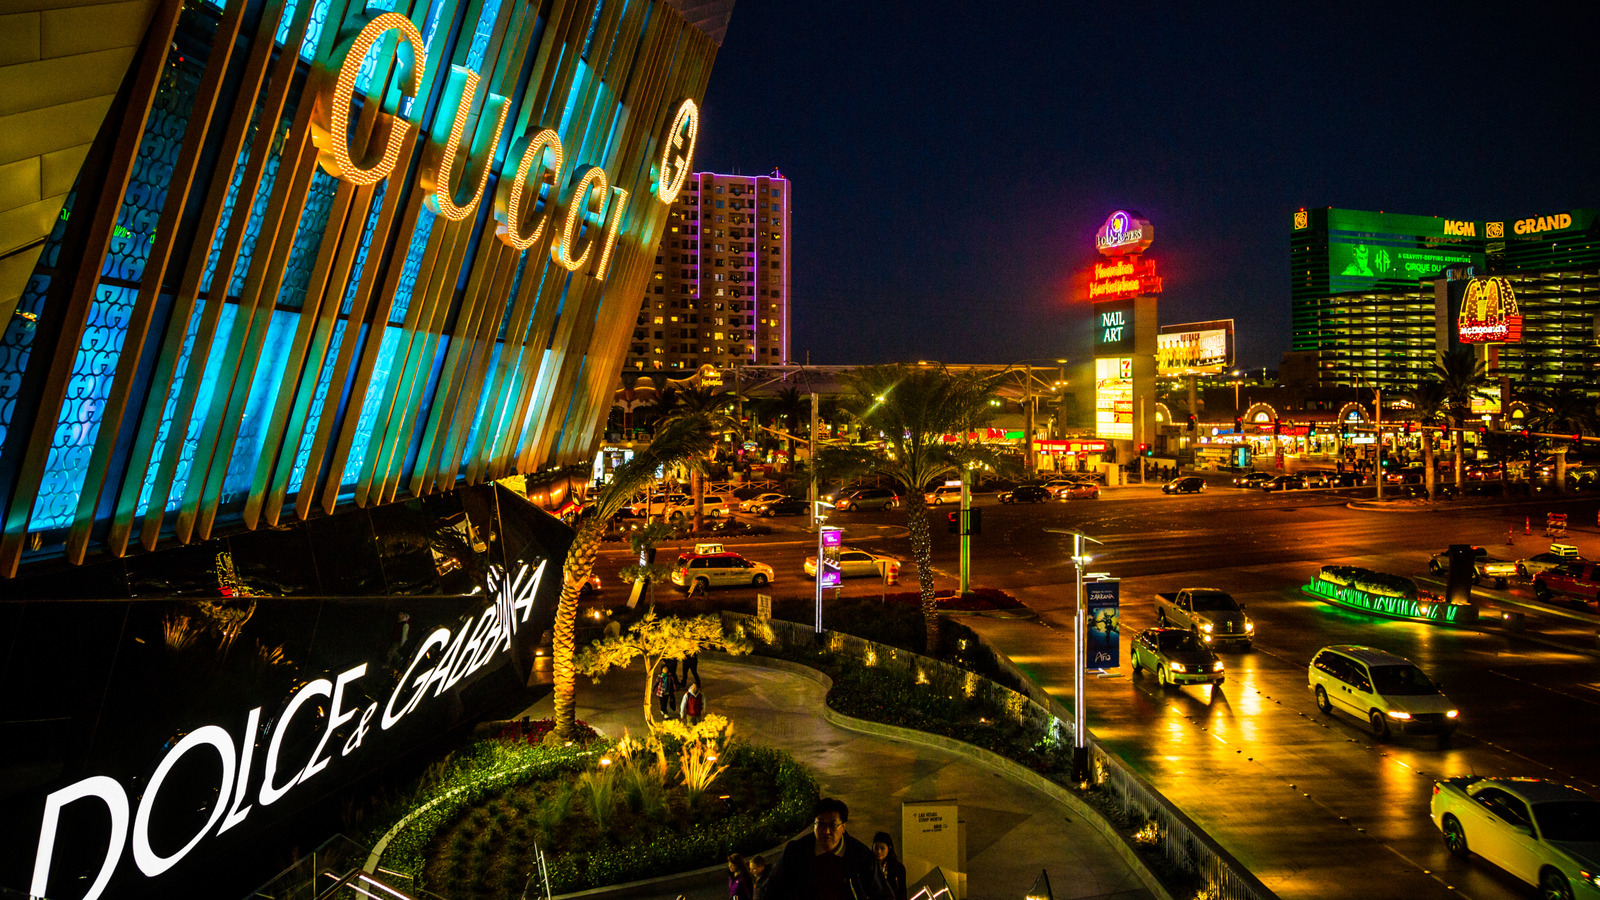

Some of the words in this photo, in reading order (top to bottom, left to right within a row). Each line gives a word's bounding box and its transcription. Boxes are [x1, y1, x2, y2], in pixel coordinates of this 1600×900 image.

[325, 12, 629, 281] GUCCI
[1443, 219, 1476, 237] MGM
[1513, 213, 1572, 235] GRAND
[1405, 262, 1431, 273] CIRQUE
[1431, 264, 1442, 272] DU
[1102, 310, 1125, 327] NAIL
[1103, 326, 1123, 343] ART
[30, 663, 368, 900] DOLCE
[342, 701, 378, 757] &
[381, 558, 548, 730] GABBANA
